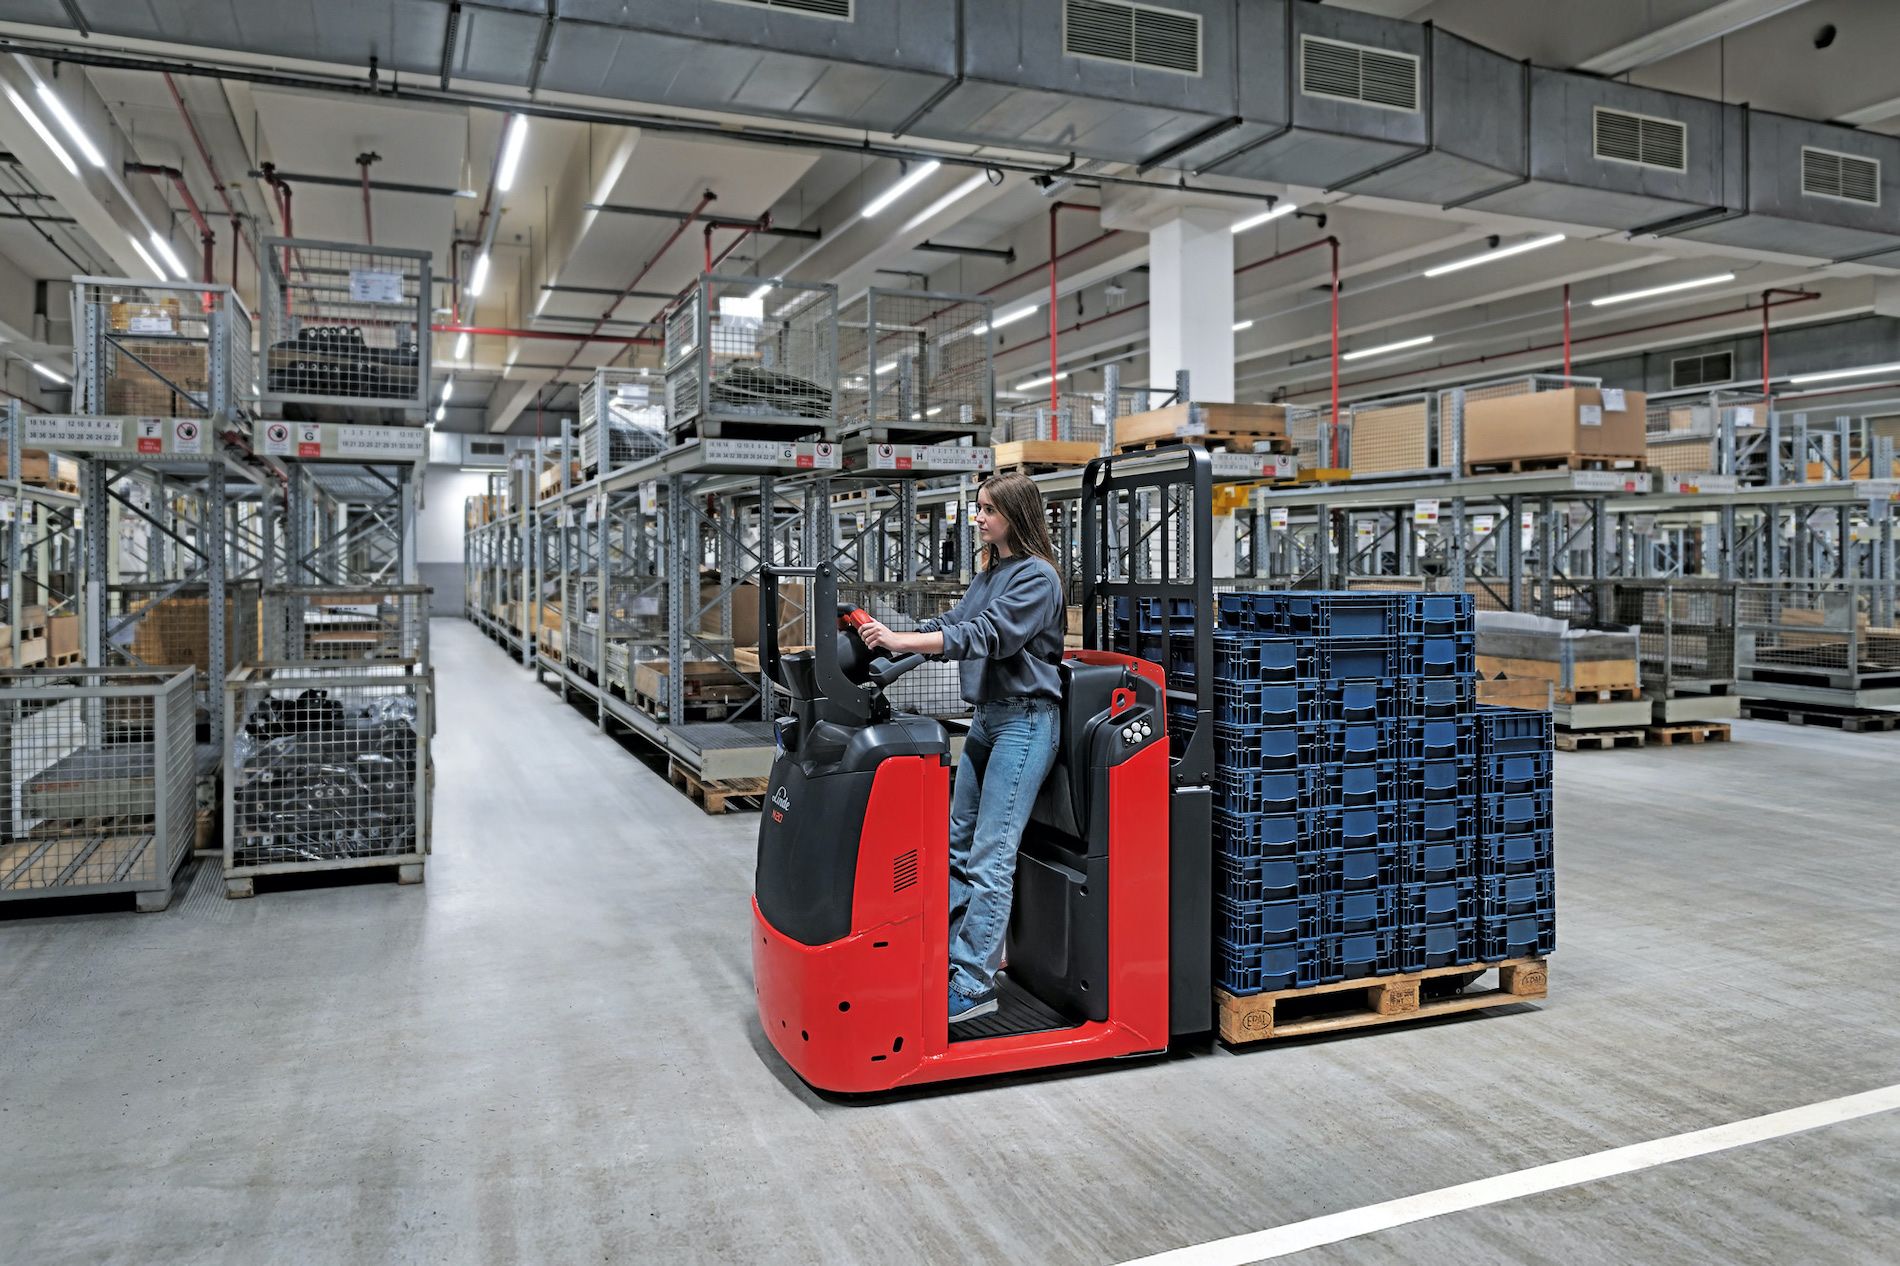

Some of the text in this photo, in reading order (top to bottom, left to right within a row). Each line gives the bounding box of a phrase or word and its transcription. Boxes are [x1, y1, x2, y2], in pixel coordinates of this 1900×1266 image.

[146, 426, 154, 436] F
[304, 432, 314, 441] G
[772, 786, 790, 811] Linde
